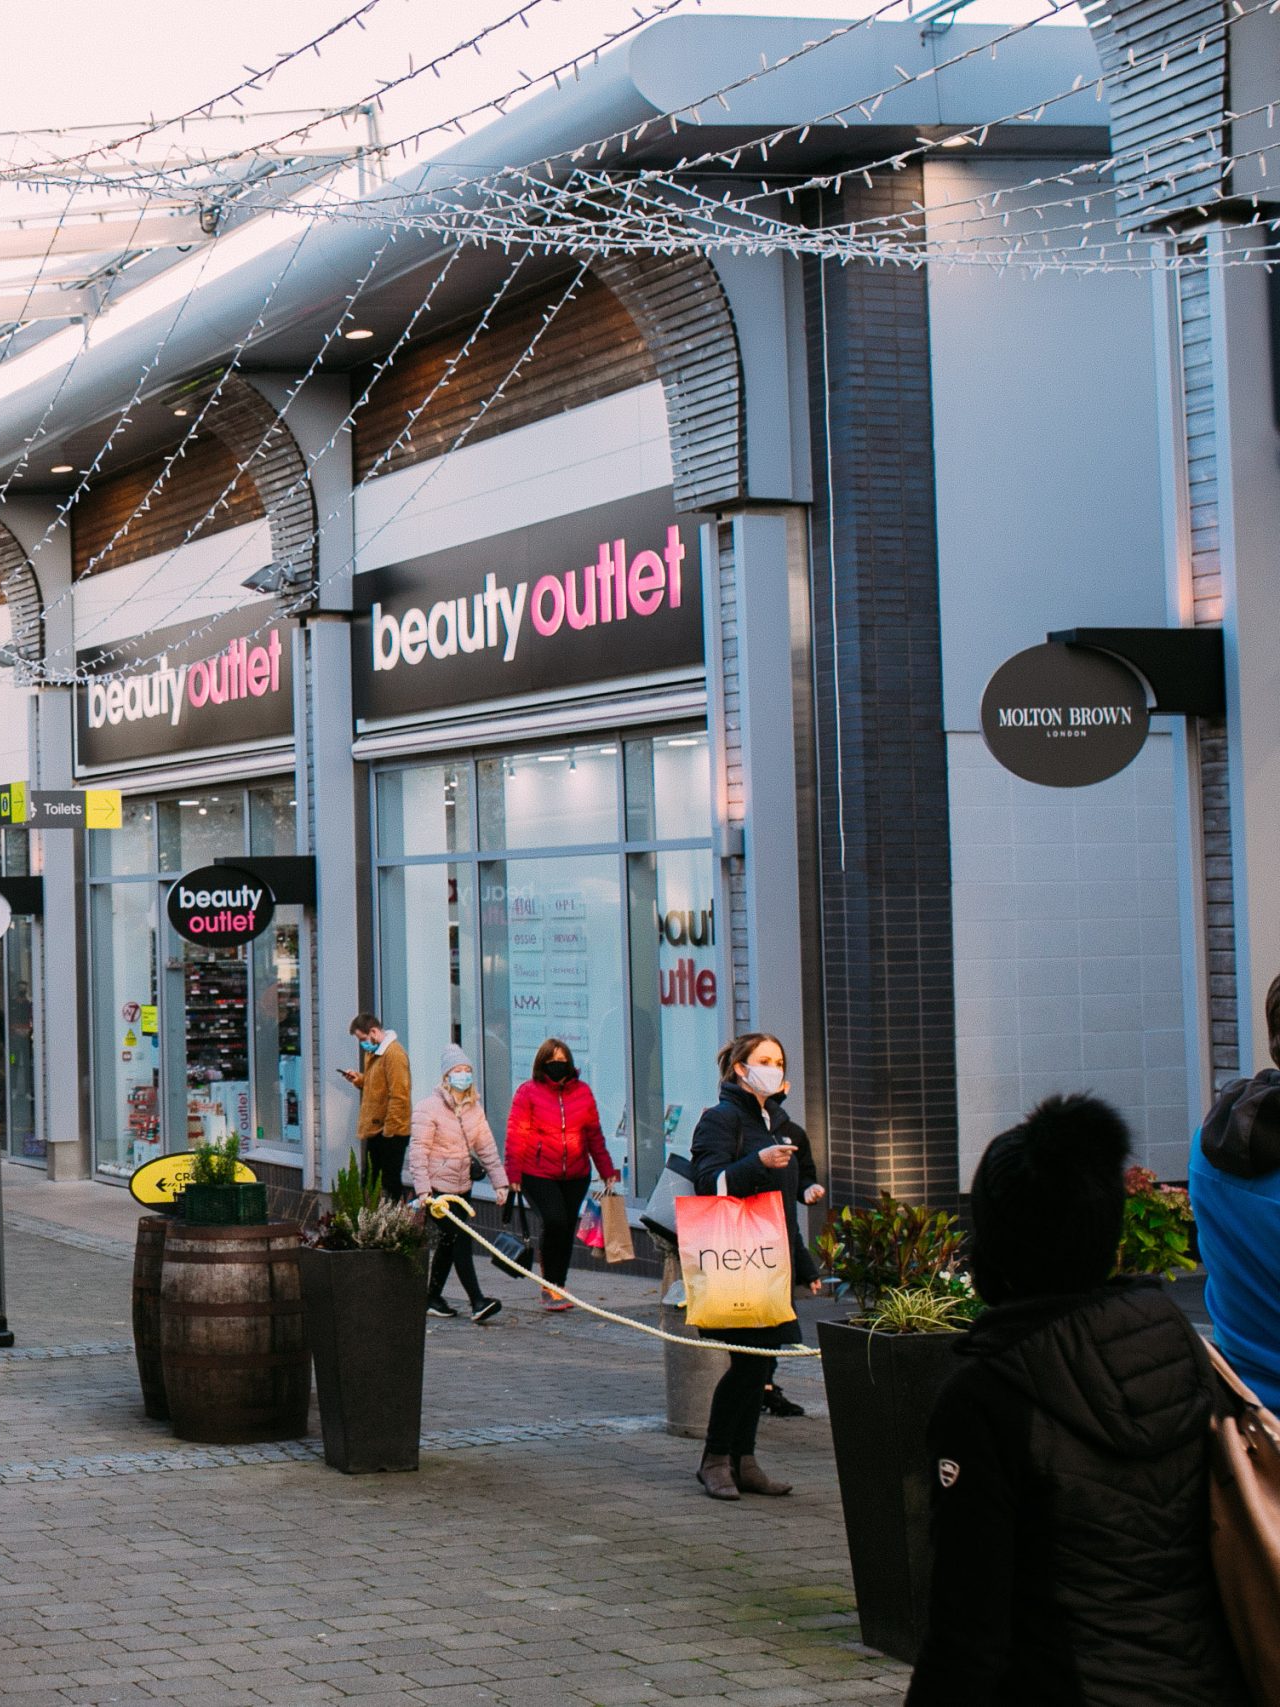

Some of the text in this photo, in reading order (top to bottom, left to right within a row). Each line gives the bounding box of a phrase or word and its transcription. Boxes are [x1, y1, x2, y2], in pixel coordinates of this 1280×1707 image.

[372, 525, 686, 671] beauty outlet
[88, 629, 281, 726] beauty outlet
[999, 706, 1132, 727] MOLTON BROWN
[1046, 730, 1087, 738] LONDON
[43, 802, 82, 815] Toilets
[179, 885, 263, 911] beauty
[189, 910, 256, 933] outlet
[699, 1245, 777, 1271] next
